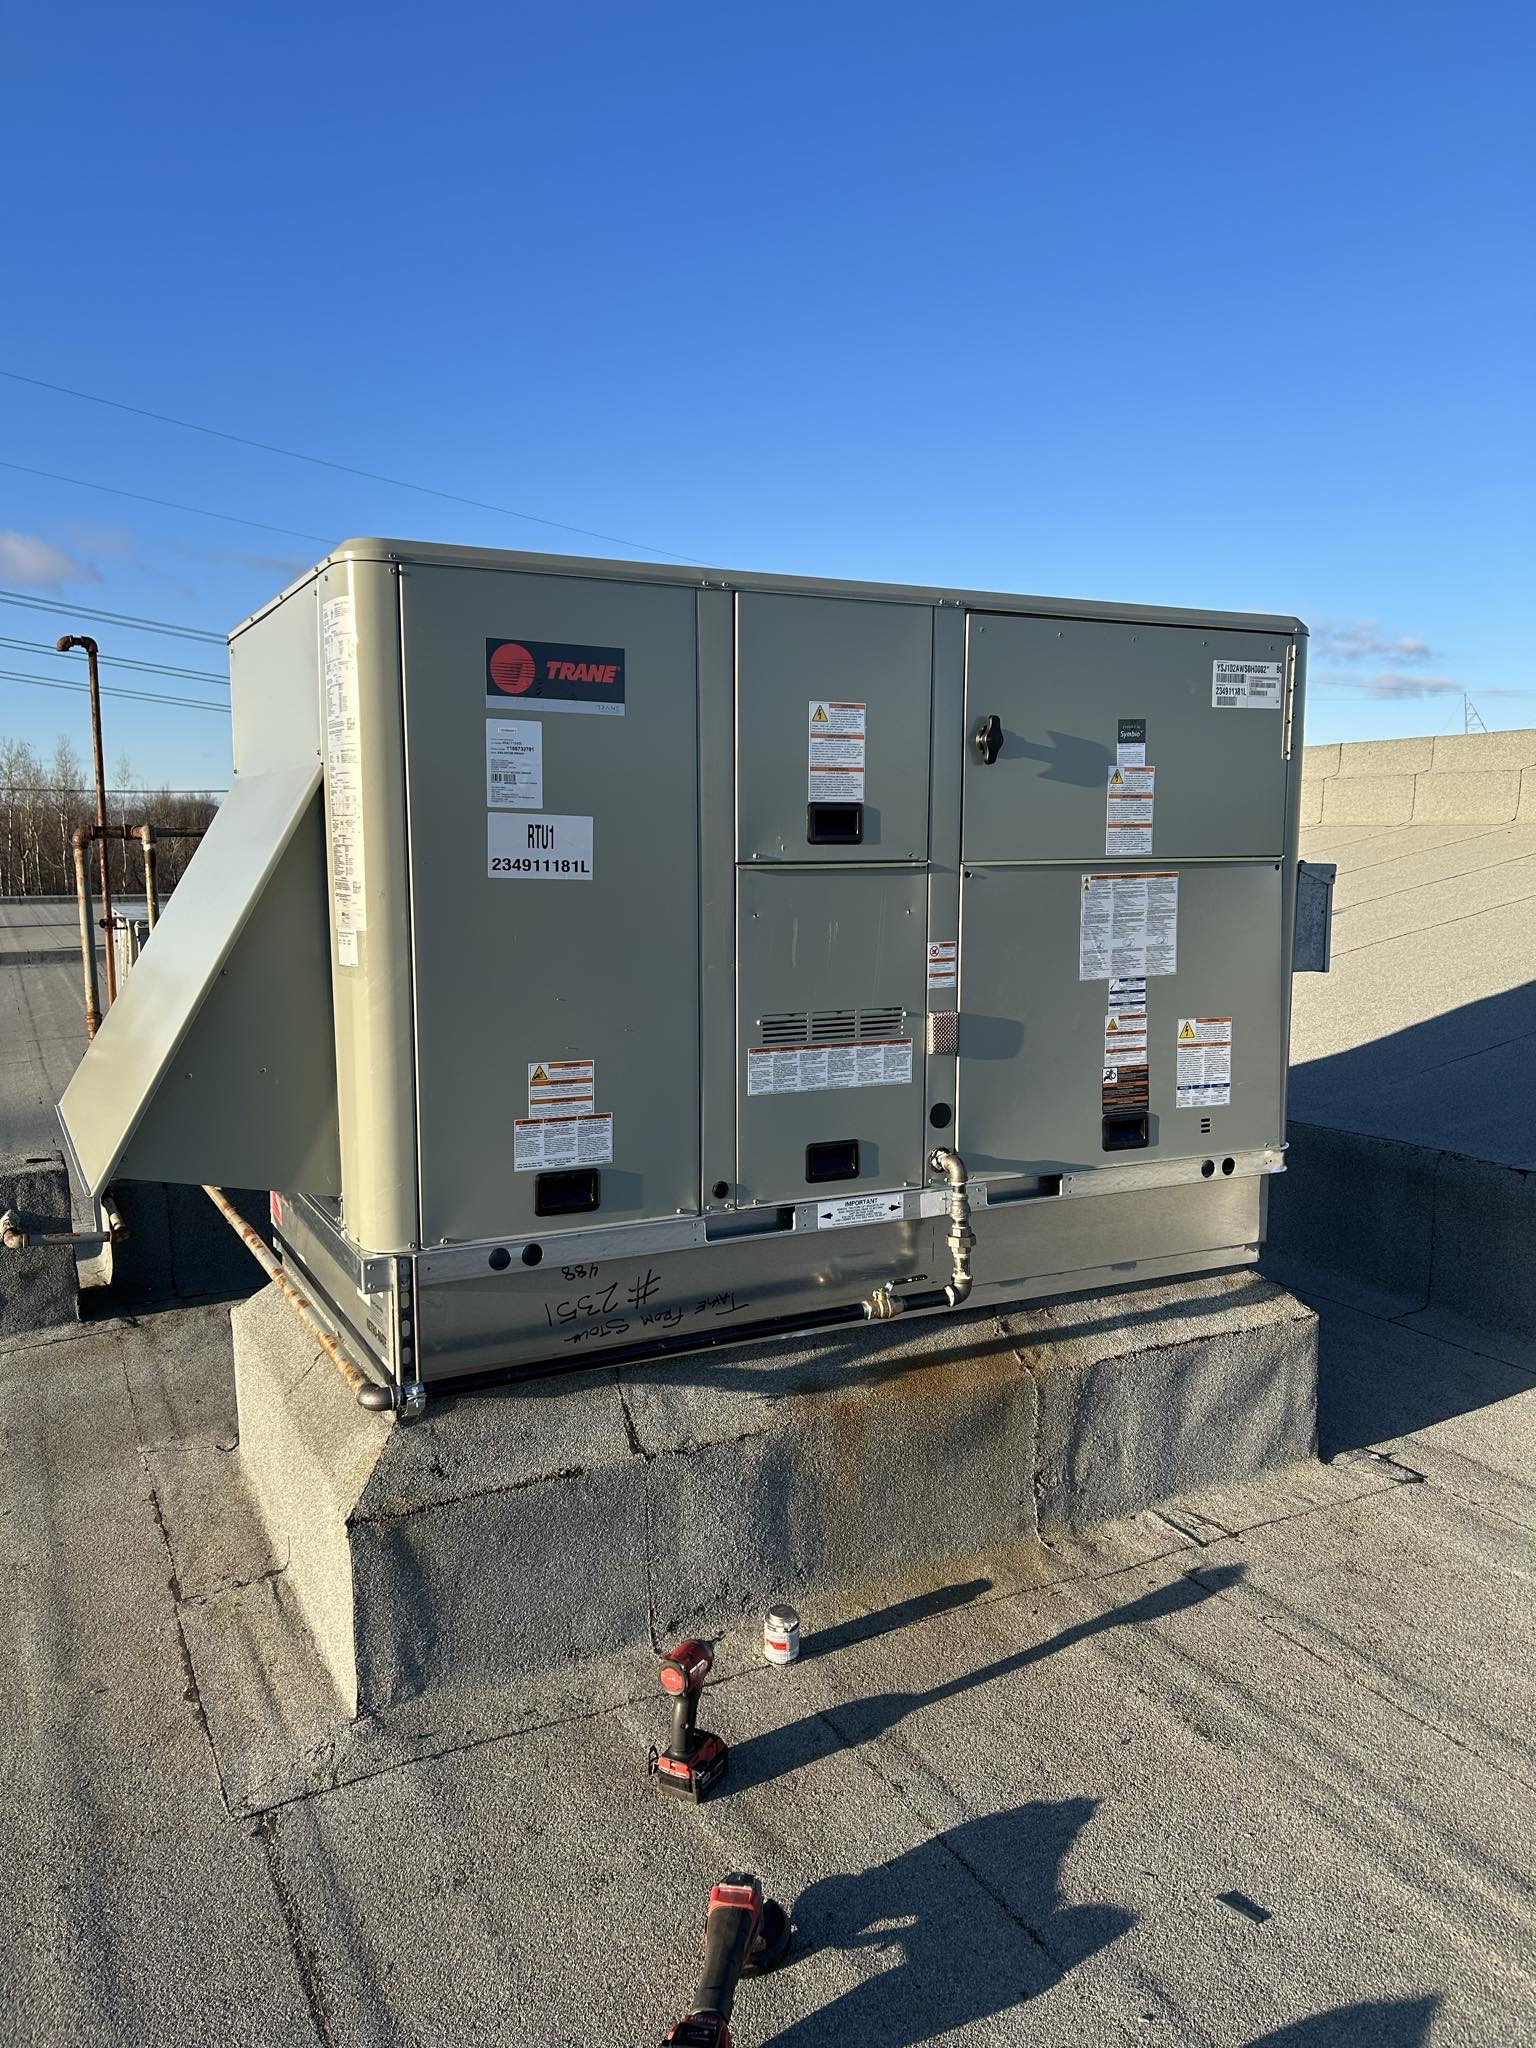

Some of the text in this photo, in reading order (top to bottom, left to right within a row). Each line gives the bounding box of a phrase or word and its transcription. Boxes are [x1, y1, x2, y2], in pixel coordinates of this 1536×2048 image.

[546, 661, 616, 683] TRANE
[527, 824, 554, 849] RTU1
[491, 858, 590, 873] 234911181L
[845, 1198, 878, 1207] IMPORTANT
[561, 1263, 599, 1281] 488
[641, 1307, 684, 1328] FROM
